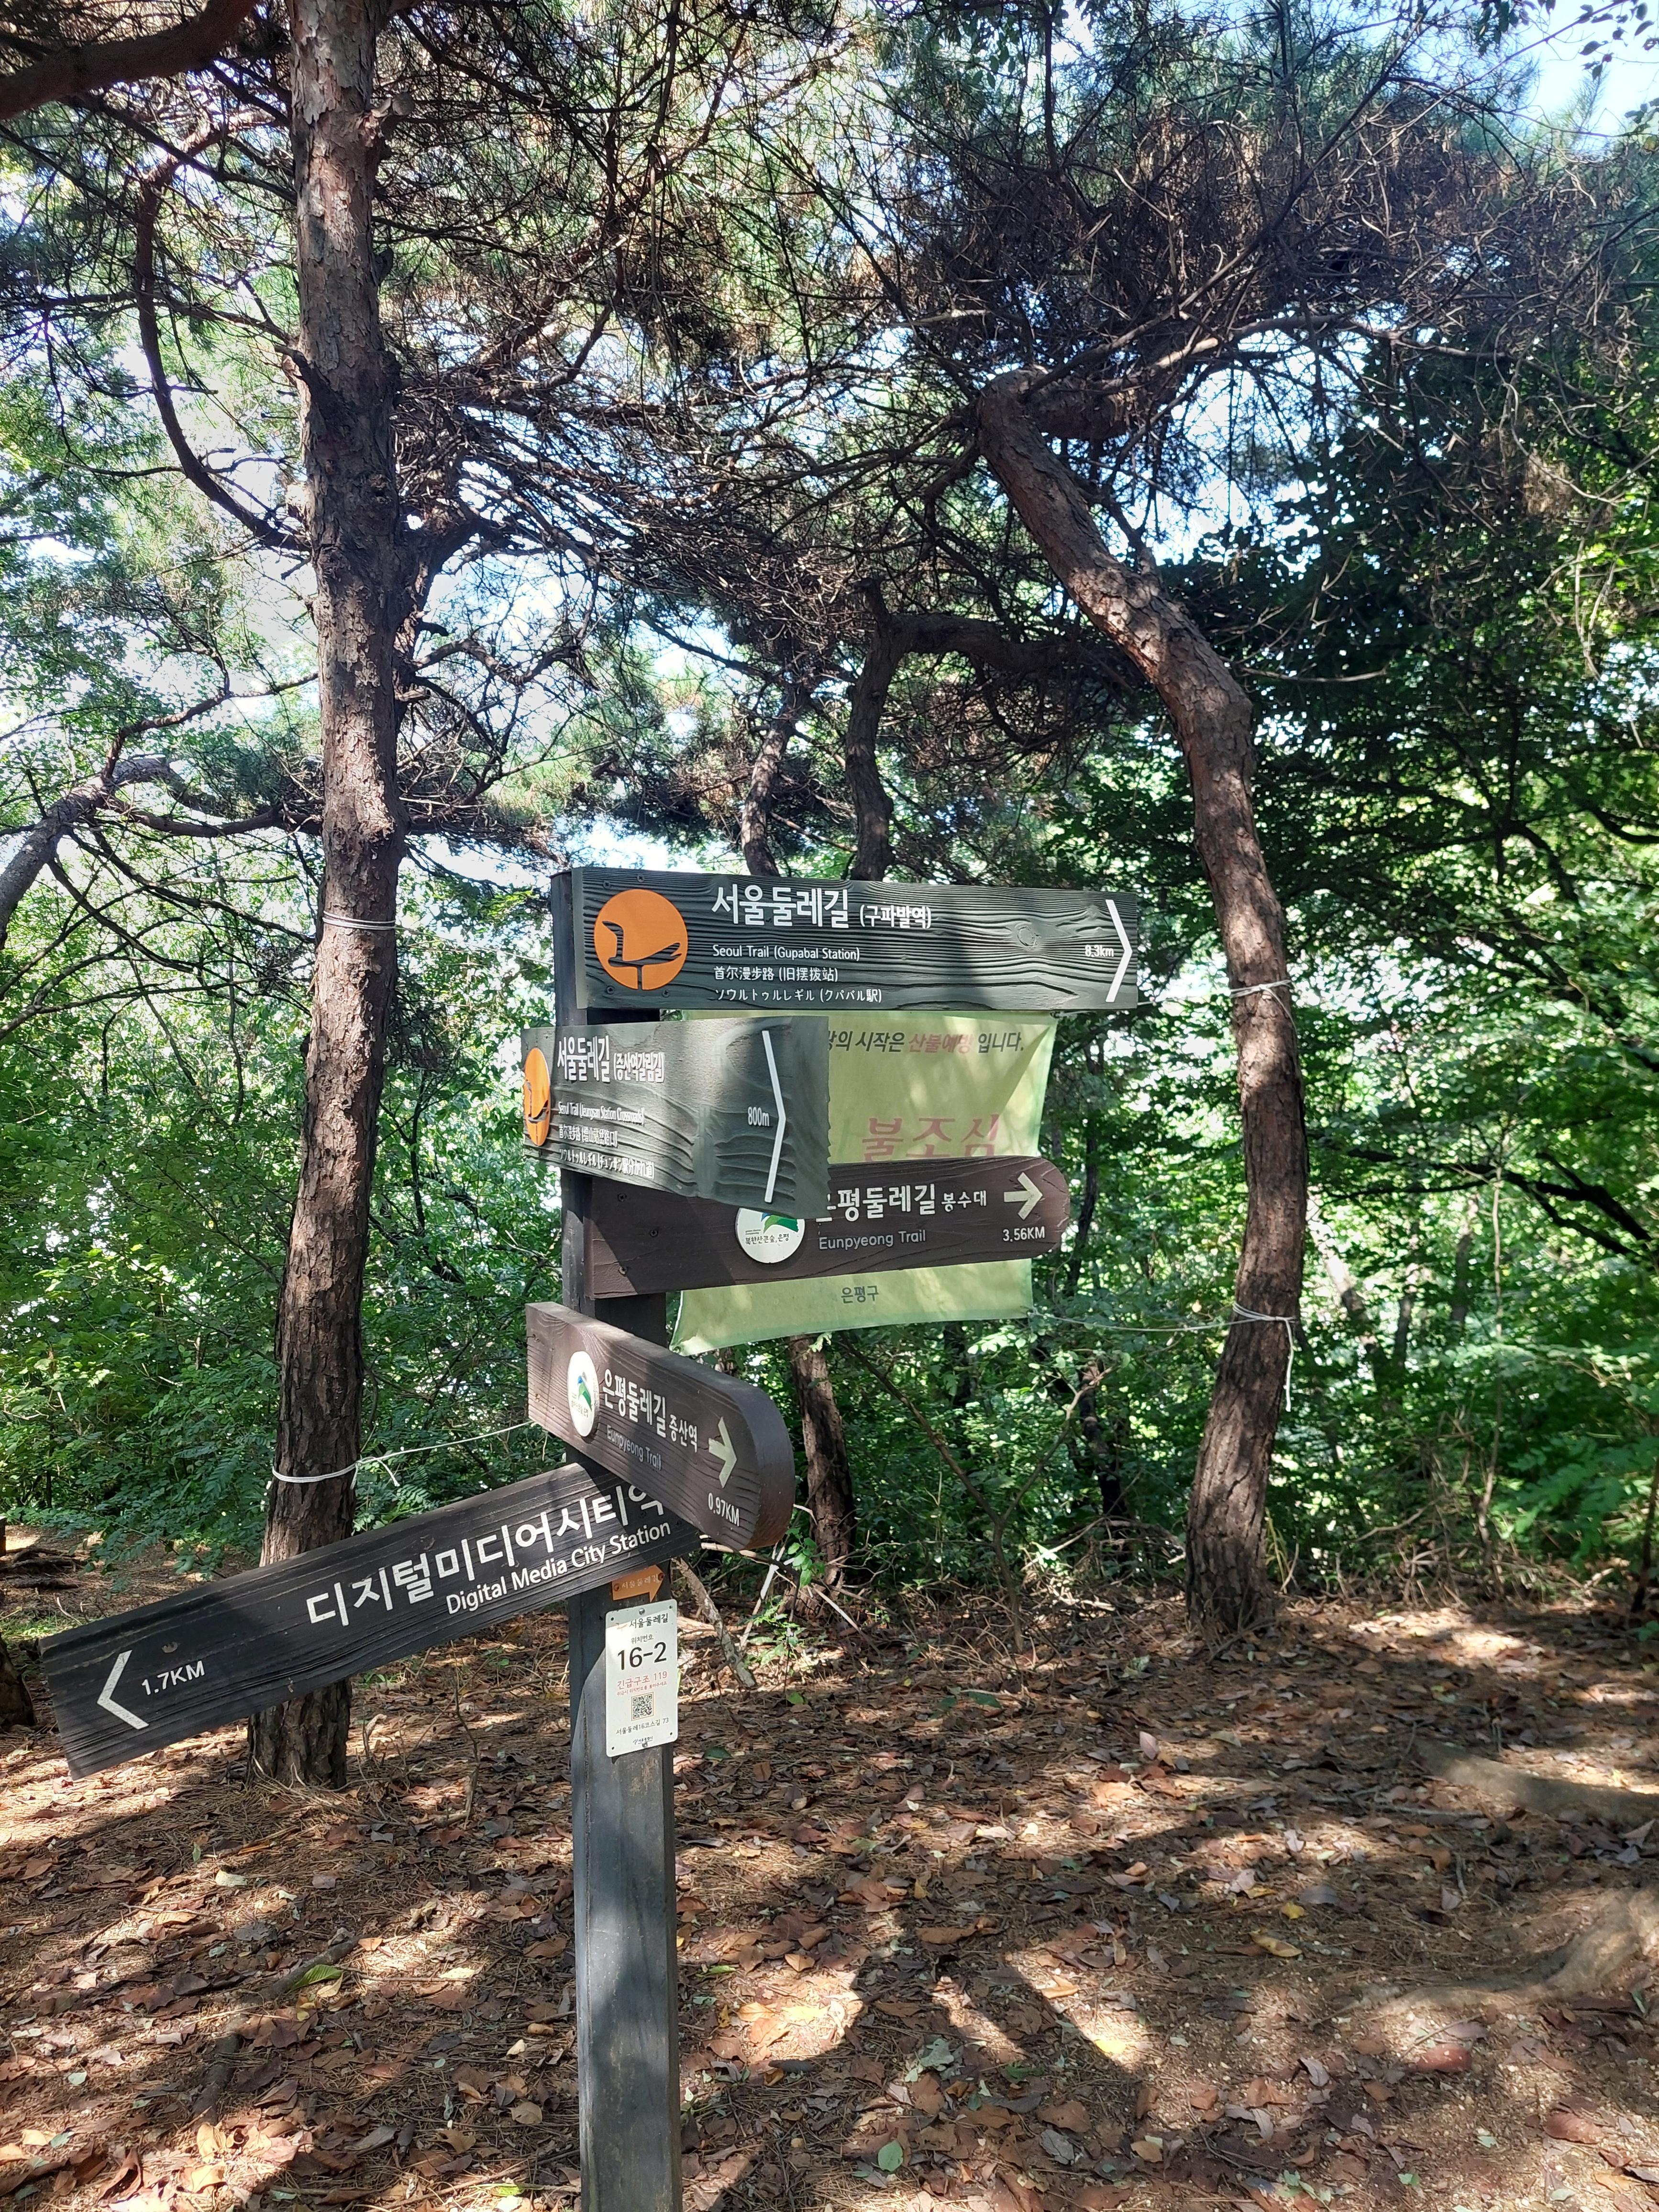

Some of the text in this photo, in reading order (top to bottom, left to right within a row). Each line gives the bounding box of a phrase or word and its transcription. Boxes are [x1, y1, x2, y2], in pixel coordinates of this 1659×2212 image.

[712, 884, 932, 929] 서울둘레길 (구파발역)
[713, 945, 860, 962] Seoul Trail (Gupabal Station)
[1085, 944, 1114, 957] 8.3km
[714, 966, 774, 981] 首尔漫步路
[820, 989, 882, 1003] (クパバル駅)
[855, 1031, 905, 1052] 시작은
[908, 1033, 974, 1053] 산불예방
[978, 1032, 1024, 1053] 입니다.
[557, 1035, 610, 1082] 서울둘레길
[748, 1106, 770, 1127] 800m
[941, 1190, 987, 1212] 봉수대
[819, 1229, 926, 1250] Eunpyeong Trail
[1002, 1226, 1046, 1242] 3.56KM
[841, 1285, 879, 1304] 은평구
[603, 1369, 697, 1453] 은평둘레길 증산역
[607, 1425, 661, 1471] Eunpyeong Trail
[708, 1493, 740, 1526] 0.97KM
[446, 1521, 671, 1615] Digital Media City Station
[622, 1573, 660, 1589] 서울둘레길
[629, 1613, 668, 1628] 서울둘레길
[631, 1633, 654, 1644] 위치번호
[617, 1642, 667, 1670] 16-2
[141, 1659, 206, 1696] 1.7KM
[617, 1671, 667, 1689] 긴급구조 119
